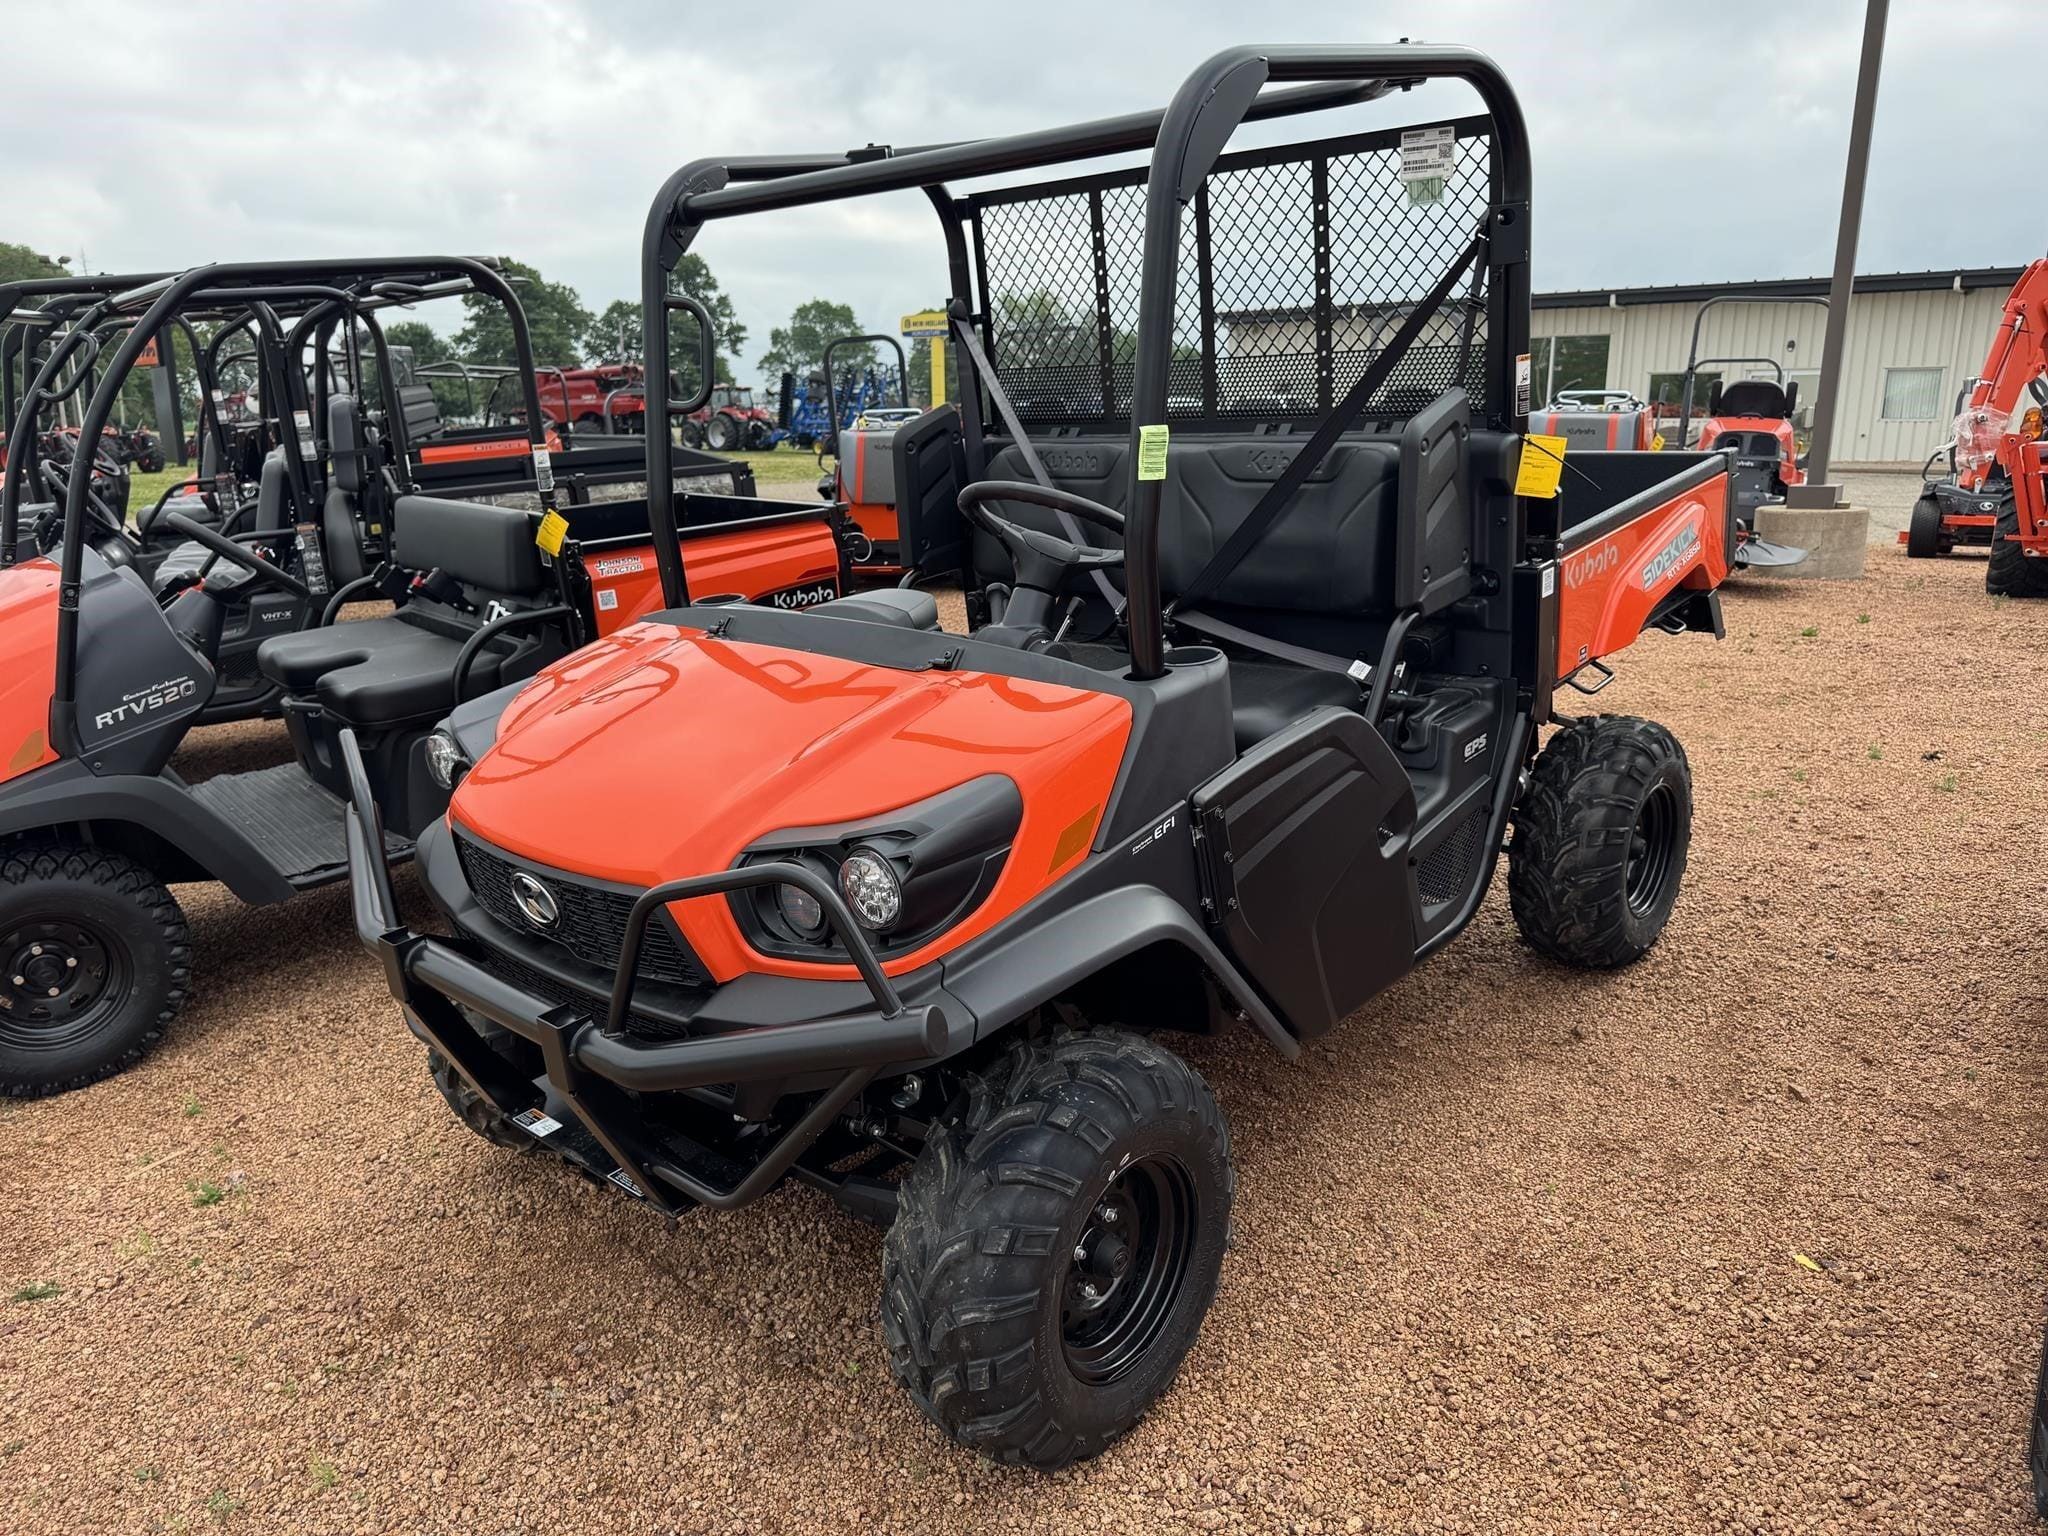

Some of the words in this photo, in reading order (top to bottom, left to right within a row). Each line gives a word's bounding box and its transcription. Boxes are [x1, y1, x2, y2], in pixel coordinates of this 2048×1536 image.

[595, 556, 640, 568] JOHNSON
[1565, 541, 1619, 590] Kubota
[1642, 520, 1699, 590] SIDEKICK
[599, 565, 643, 577] TRACTOR
[773, 586, 835, 609] Kubota
[95, 680, 196, 729] RTV520
[1464, 733, 1487, 758] EPS
[1154, 816, 1175, 840] EFI
